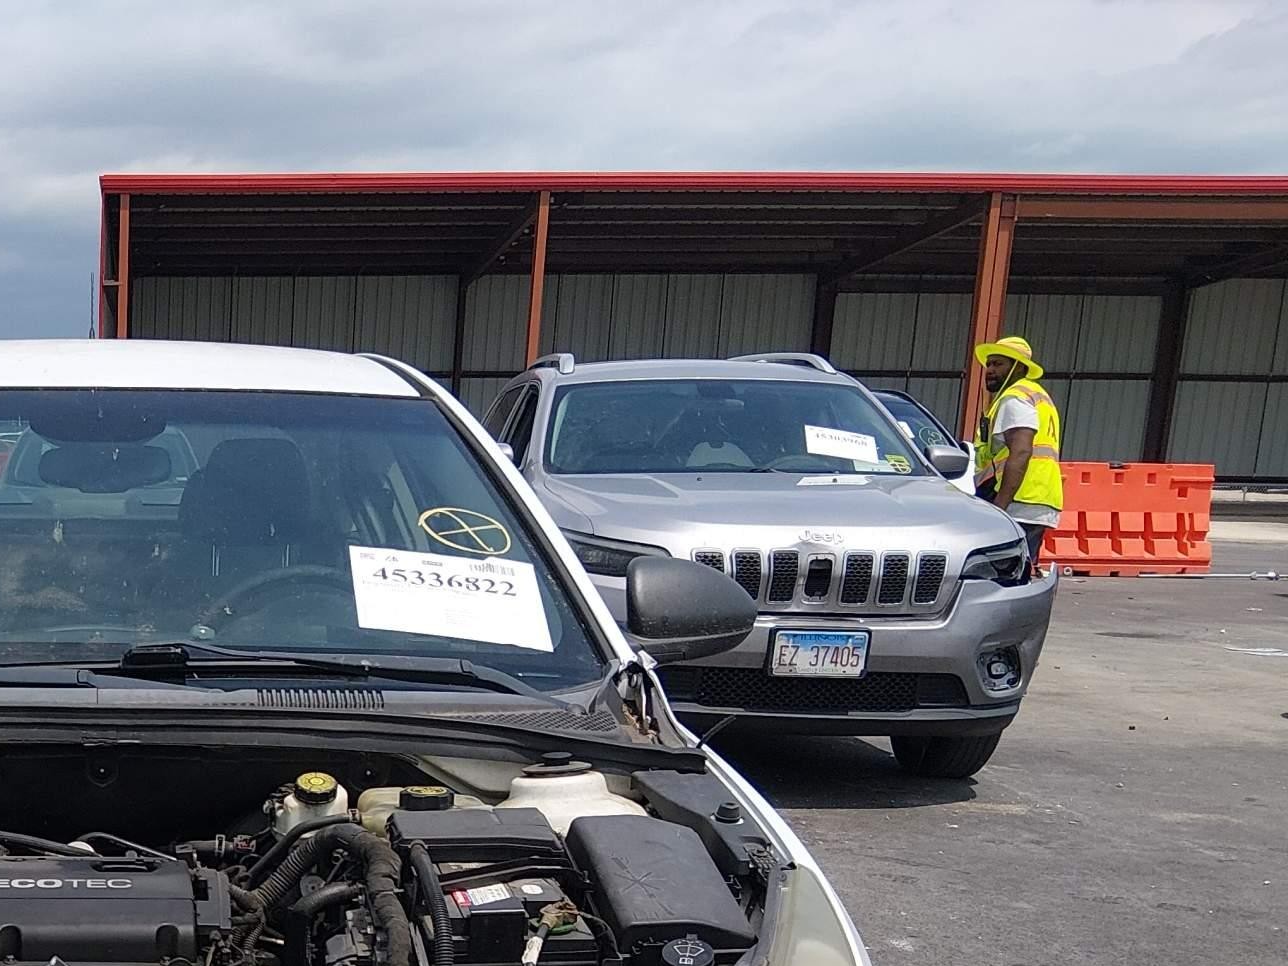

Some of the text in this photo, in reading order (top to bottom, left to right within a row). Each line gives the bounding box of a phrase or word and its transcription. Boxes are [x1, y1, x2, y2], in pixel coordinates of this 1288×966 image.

[798, 529, 844, 545] Jeep
[372, 567, 517, 597] 45336822
[778, 645, 861, 667] EZ 37405
